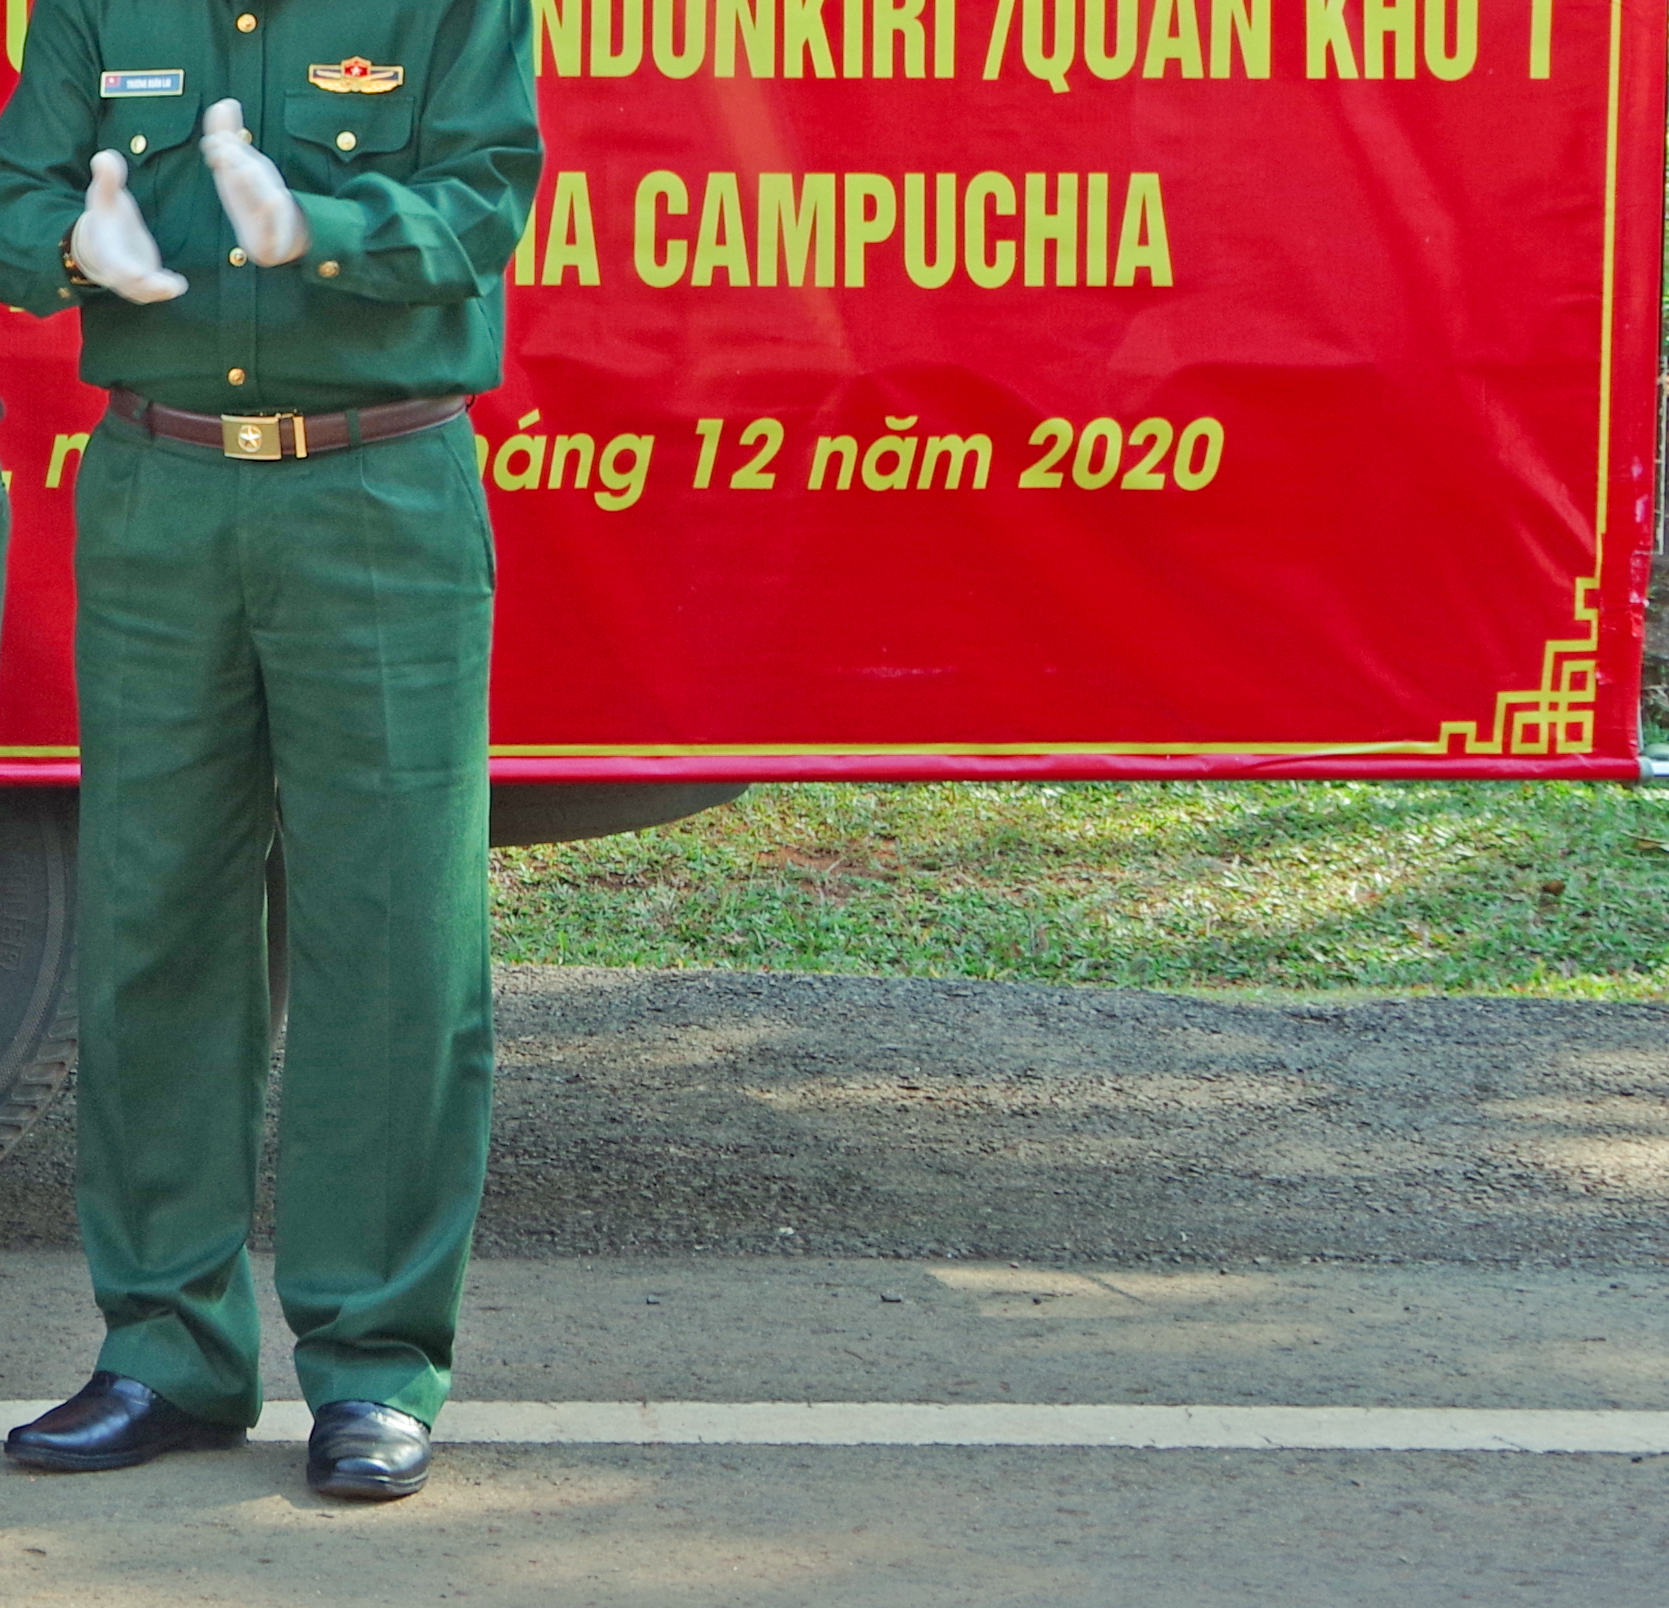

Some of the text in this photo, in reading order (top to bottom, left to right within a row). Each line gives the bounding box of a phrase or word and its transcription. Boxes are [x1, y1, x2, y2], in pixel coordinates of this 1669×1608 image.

[633, 169, 1174, 290] CAMPUCHIA
[693, 417, 785, 490] 12
[807, 415, 993, 492] năm
[1018, 416, 1225, 491] 2020
